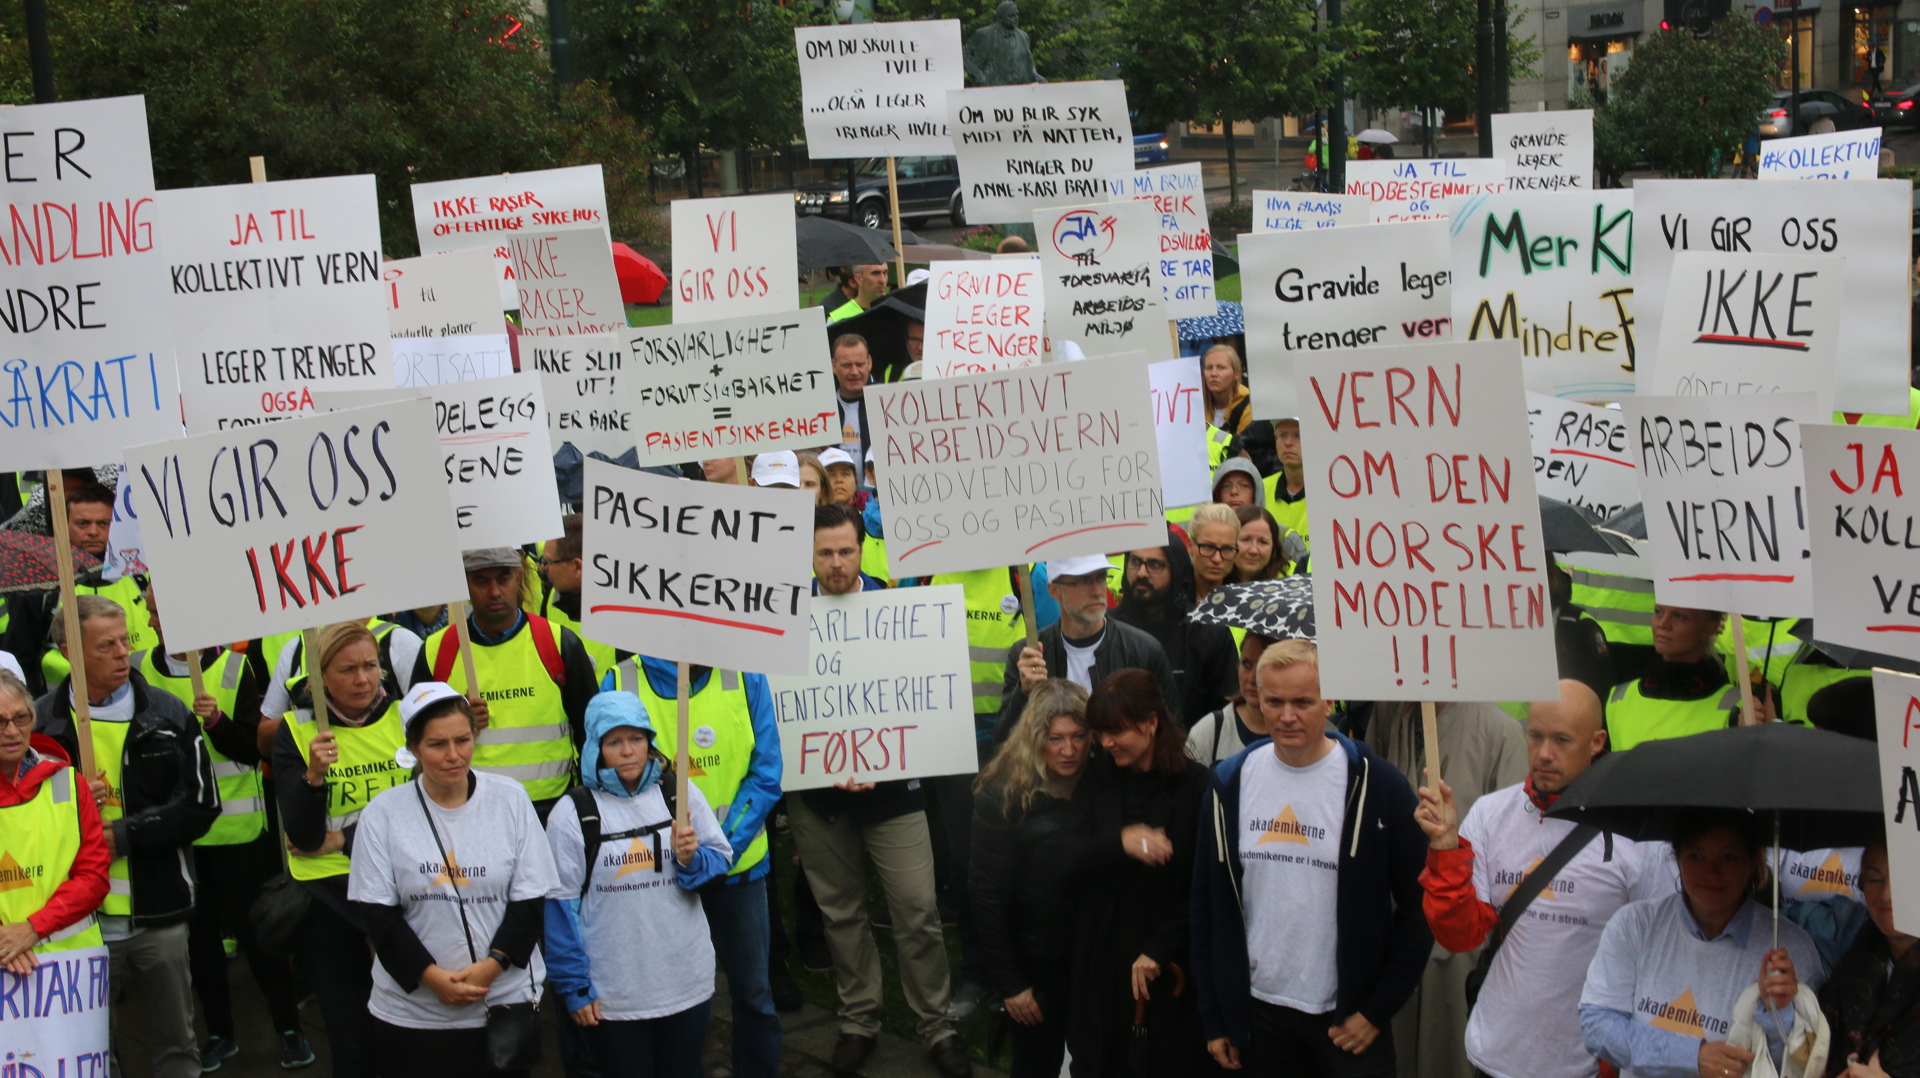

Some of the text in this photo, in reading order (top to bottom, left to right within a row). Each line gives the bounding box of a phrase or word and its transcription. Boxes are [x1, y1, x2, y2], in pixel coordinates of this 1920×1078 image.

[805, 37, 920, 60] OM DU SKULLE
[885, 58, 937, 75] TVILE
[876, 92, 926, 109] LEGER
[959, 105, 1102, 124] OM DU BLIR SYK
[835, 121, 951, 141] TRENGER HVILE
[962, 124, 1122, 145] MIDT PÅ NATTEN,
[1006, 157, 1094, 176] RINGER DU
[1109, 179, 1125, 196] VI
[1133, 171, 1154, 194] MÅ
[1393, 161, 1467, 178] JA TIL
[433, 191, 545, 218] IKKE RASER
[972, 179, 1058, 199] ANNE-KARI
[1410, 201, 1430, 212] OG
[229, 208, 316, 246] JA TIL
[532, 208, 600, 226] SYKEHUS
[706, 210, 738, 253] VI
[1660, 213, 1838, 253] VI GIR OSS
[510, 237, 567, 281] IKKE
[1479, 208, 1580, 279] Mer
[170, 250, 380, 294] KOLLEKTIVT VERN
[679, 266, 768, 302] GIR OSS
[938, 271, 1034, 300] GRAVIDE
[1182, 259, 1212, 278] TAR
[1274, 265, 1380, 303] Gravide
[519, 288, 596, 319] RASER
[1175, 285, 1212, 301] GITT
[1698, 268, 1818, 340] IKKE
[955, 303, 1030, 327] LEGER
[1467, 290, 1620, 358] Mindre
[533, 348, 573, 374] IKKE
[630, 323, 800, 366] FORSVARLIGHET
[937, 330, 1038, 357] TRENGER
[202, 342, 377, 385] LEGER TRENGER
[261, 386, 315, 413] OGSÅ
[576, 376, 616, 397] UT!
[640, 370, 824, 407] FORUTSIGBARHET
[879, 371, 1073, 429] KOLLEKTIVT
[1310, 363, 1461, 432] VERN
[559, 413, 584, 430] ER
[590, 409, 632, 432] BARE
[645, 411, 836, 455] PASIENTSIKKERHET
[141, 454, 192, 540] VI
[208, 438, 288, 528] GIR
[308, 420, 397, 511] OSS
[888, 450, 1154, 507] NØDVENDIG FOR
[1328, 450, 1511, 504] OM DEN
[1830, 442, 1903, 497] JA
[594, 485, 795, 543] PASIENT-
[894, 486, 1165, 543] OSS OG PASIENTEN
[1667, 485, 1811, 561] VERN!
[1333, 518, 1537, 573] NORSKE
[245, 524, 366, 615] IKKE
[592, 553, 810, 617] SIKKERHET
[1333, 579, 1544, 629] MODELLEN
[816, 651, 842, 676] OG
[799, 725, 918, 776] FØRST
[1249, 817, 1326, 840] akademikerne
[1295, 856, 1305, 865] er
[1558, 914, 1589, 927] streik
[1637, 997, 1729, 1035] akademikerne
